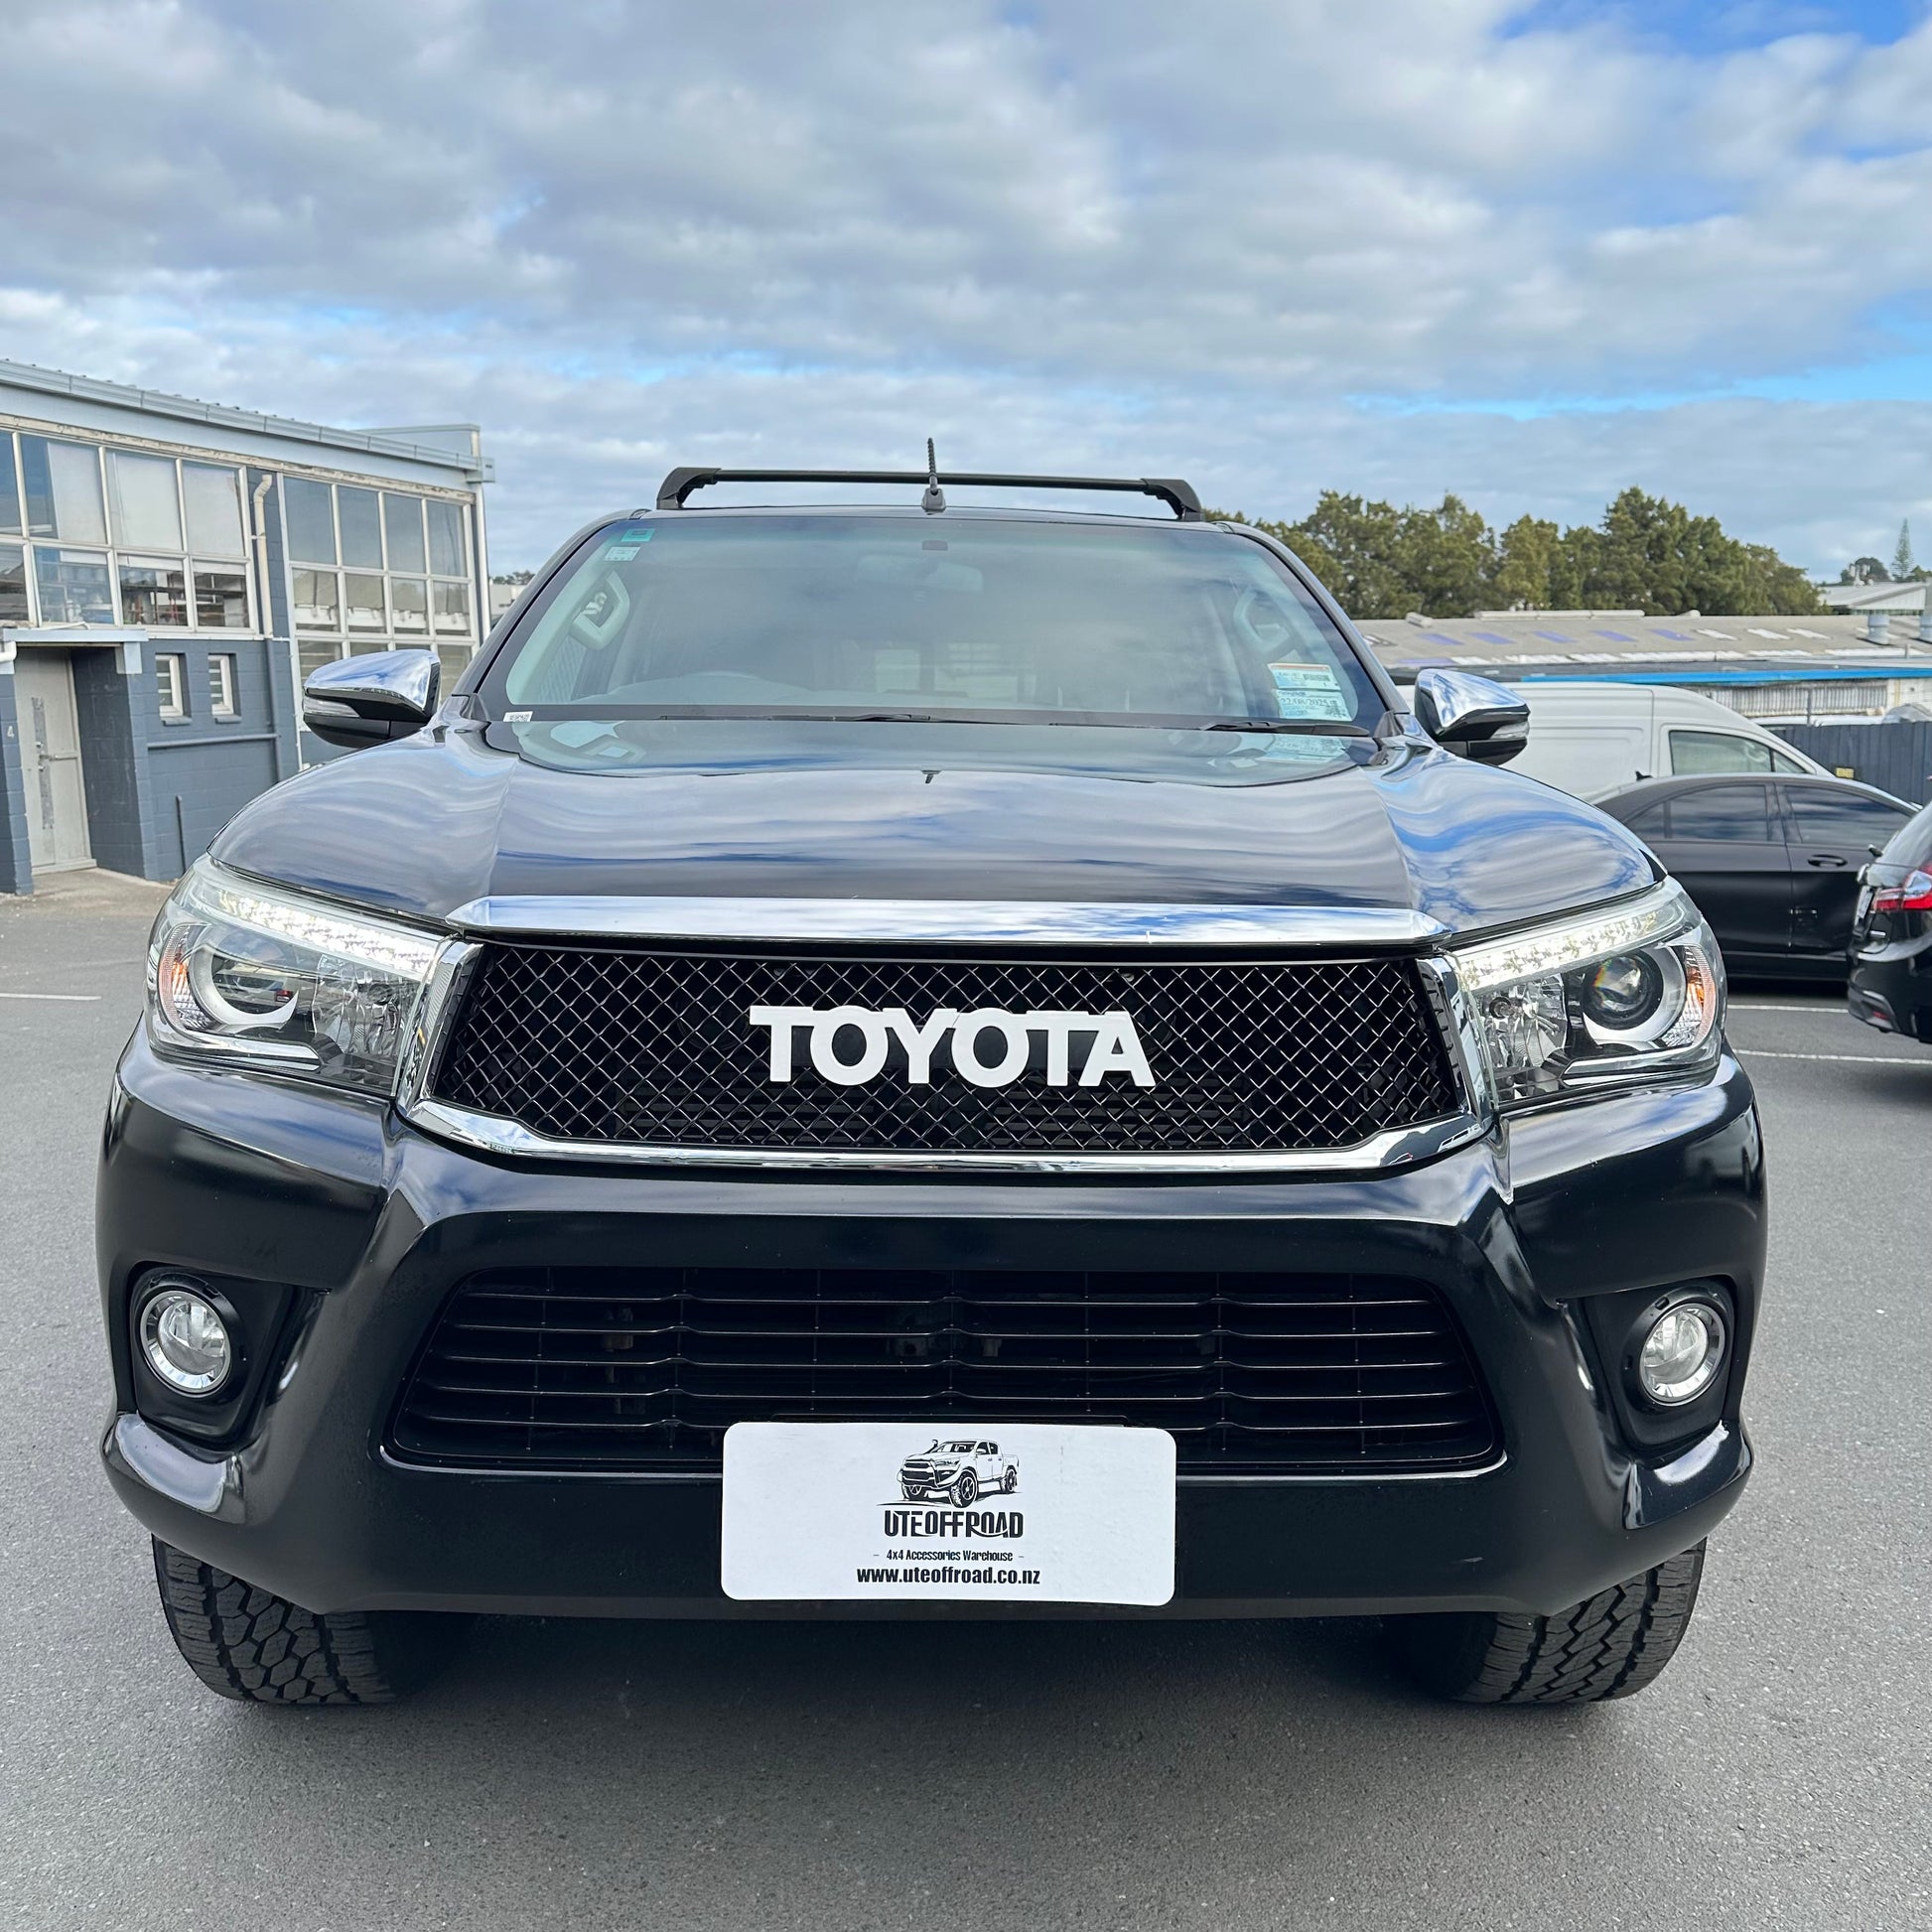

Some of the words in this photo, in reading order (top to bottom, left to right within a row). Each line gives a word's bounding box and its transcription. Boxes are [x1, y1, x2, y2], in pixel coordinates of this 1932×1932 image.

[7, 725, 15, 739] 4
[750, 1005, 1156, 1088] TOYOTA
[884, 1509, 1024, 1539] UTEOFFROAD
[886, 1549, 904, 1561] 4x4
[905, 1549, 961, 1562] Accessories
[962, 1550, 1014, 1562] Warehouse
[857, 1566, 1040, 1586] www.uteoffroad.co.nz
